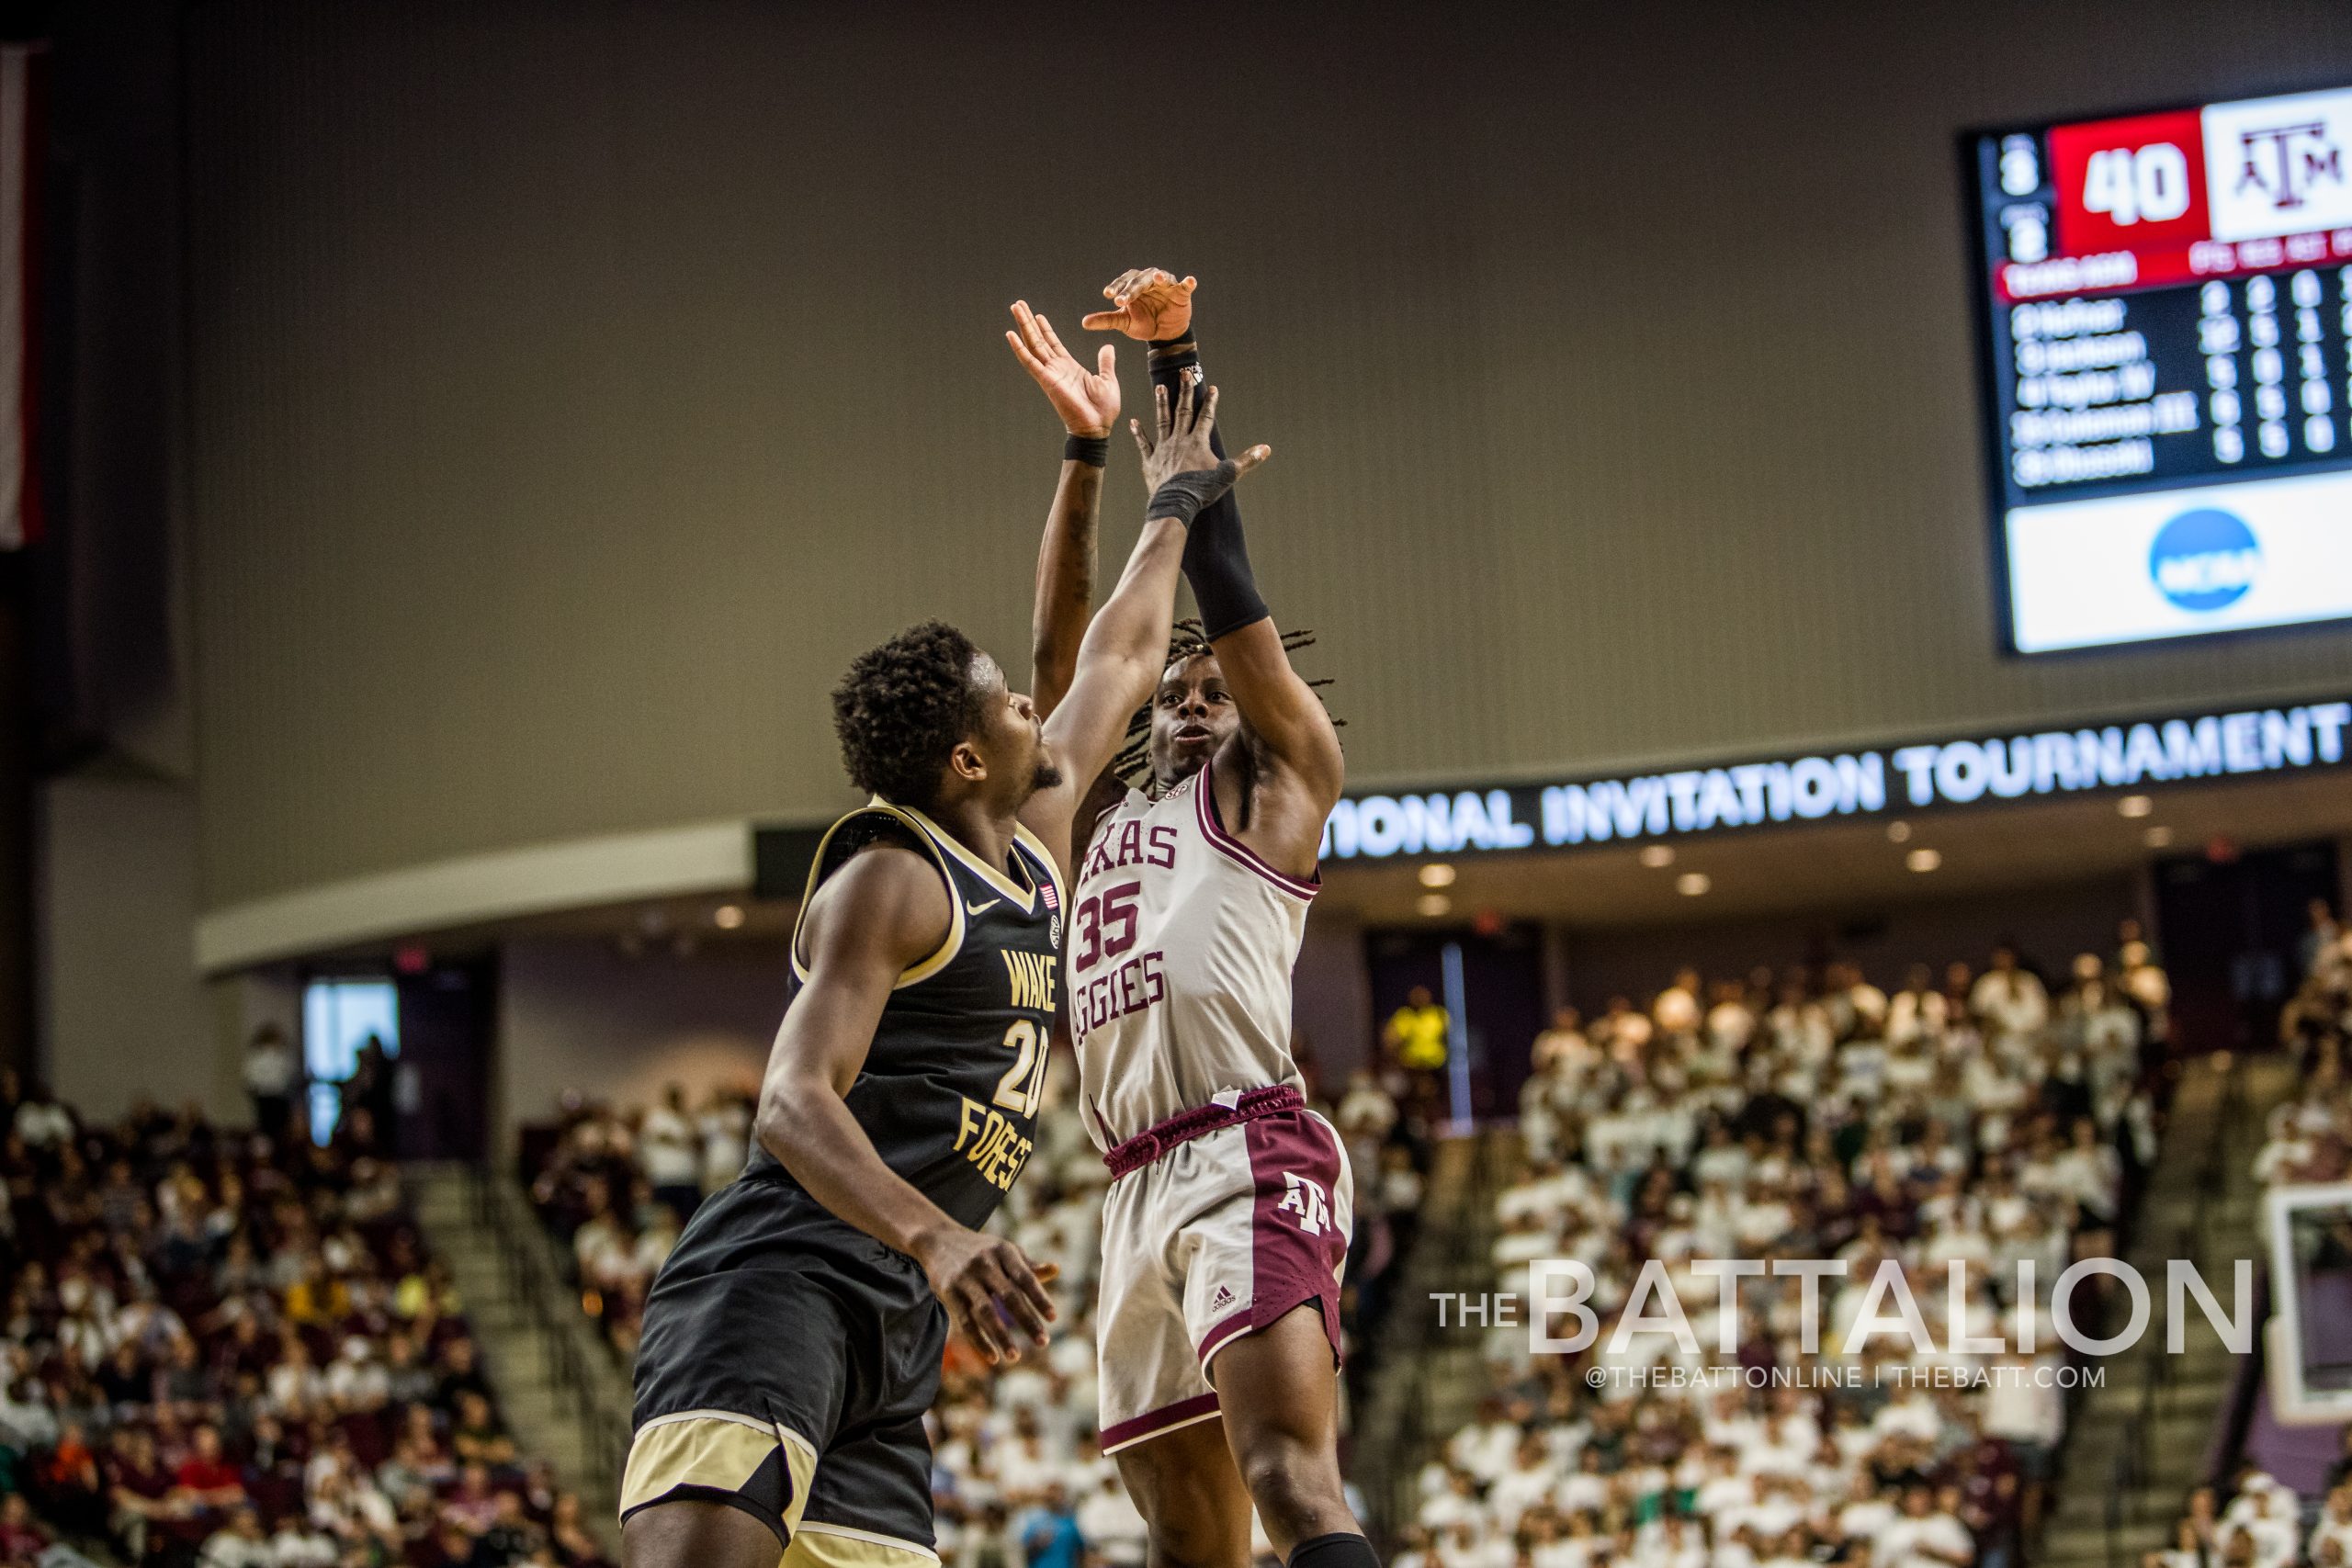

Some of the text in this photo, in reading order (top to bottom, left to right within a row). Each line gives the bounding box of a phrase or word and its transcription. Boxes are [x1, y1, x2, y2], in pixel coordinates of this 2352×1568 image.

[2083, 141, 2189, 226] 40
[1540, 750, 1886, 846] INVITATION
[1892, 701, 2351, 807] TOURNAMENT
[1076, 881, 1141, 974] 35
[1001, 949, 1057, 1012] WAKE
[992, 1019, 1049, 1120] 20
